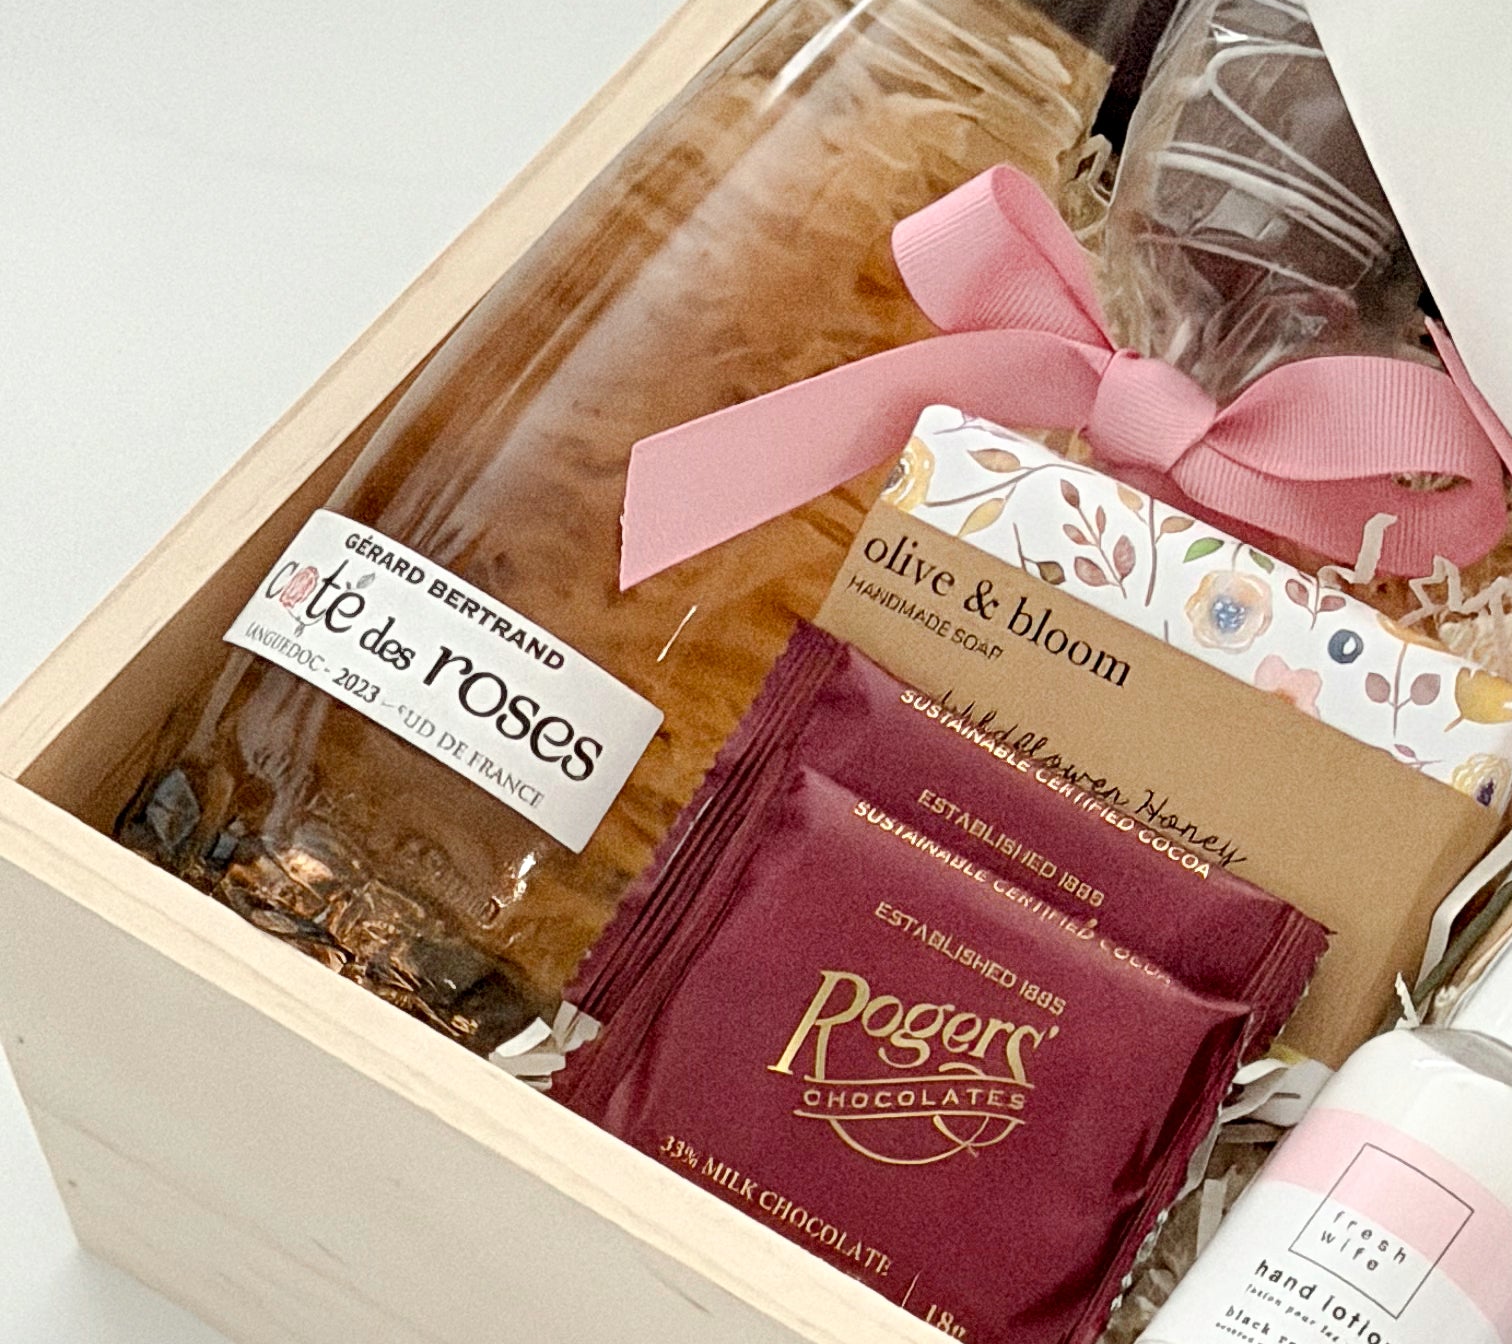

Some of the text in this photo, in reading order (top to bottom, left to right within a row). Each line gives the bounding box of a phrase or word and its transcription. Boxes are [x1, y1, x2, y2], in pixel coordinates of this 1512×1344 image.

[344, 533, 566, 671] GÉRARD BERTRAND
[848, 574, 1004, 661] HANDMADE SOAP
[864, 535, 1132, 688] olive & bloom
[245, 622, 326, 672] LANGUEDOC
[332, 667, 381, 704] 2023
[398, 704, 436, 738] SUD
[437, 731, 469, 760] DE
[467, 751, 545, 808] FRANCE
[359, 615, 416, 672] des
[423, 645, 604, 782] roses
[900, 689, 1211, 881] SUSTAINABLE CERTIFIED COCOA
[918, 789, 1058, 880] ESTABLISHED
[1136, 789, 1247, 869] Honey
[874, 901, 1067, 1017] ESTABLISHED 1885
[767, 969, 1060, 1086] Rogers'
[803, 1087, 1028, 1111] CHOCOLATES
[660, 1135, 893, 1278] 33% MILK CHOCOLATE
[1320, 1229, 1380, 1272] wife
[1333, 1210, 1407, 1265] fresh
[1225, 1305, 1271, 1336] black
[1254, 1259, 1318, 1301] hand
